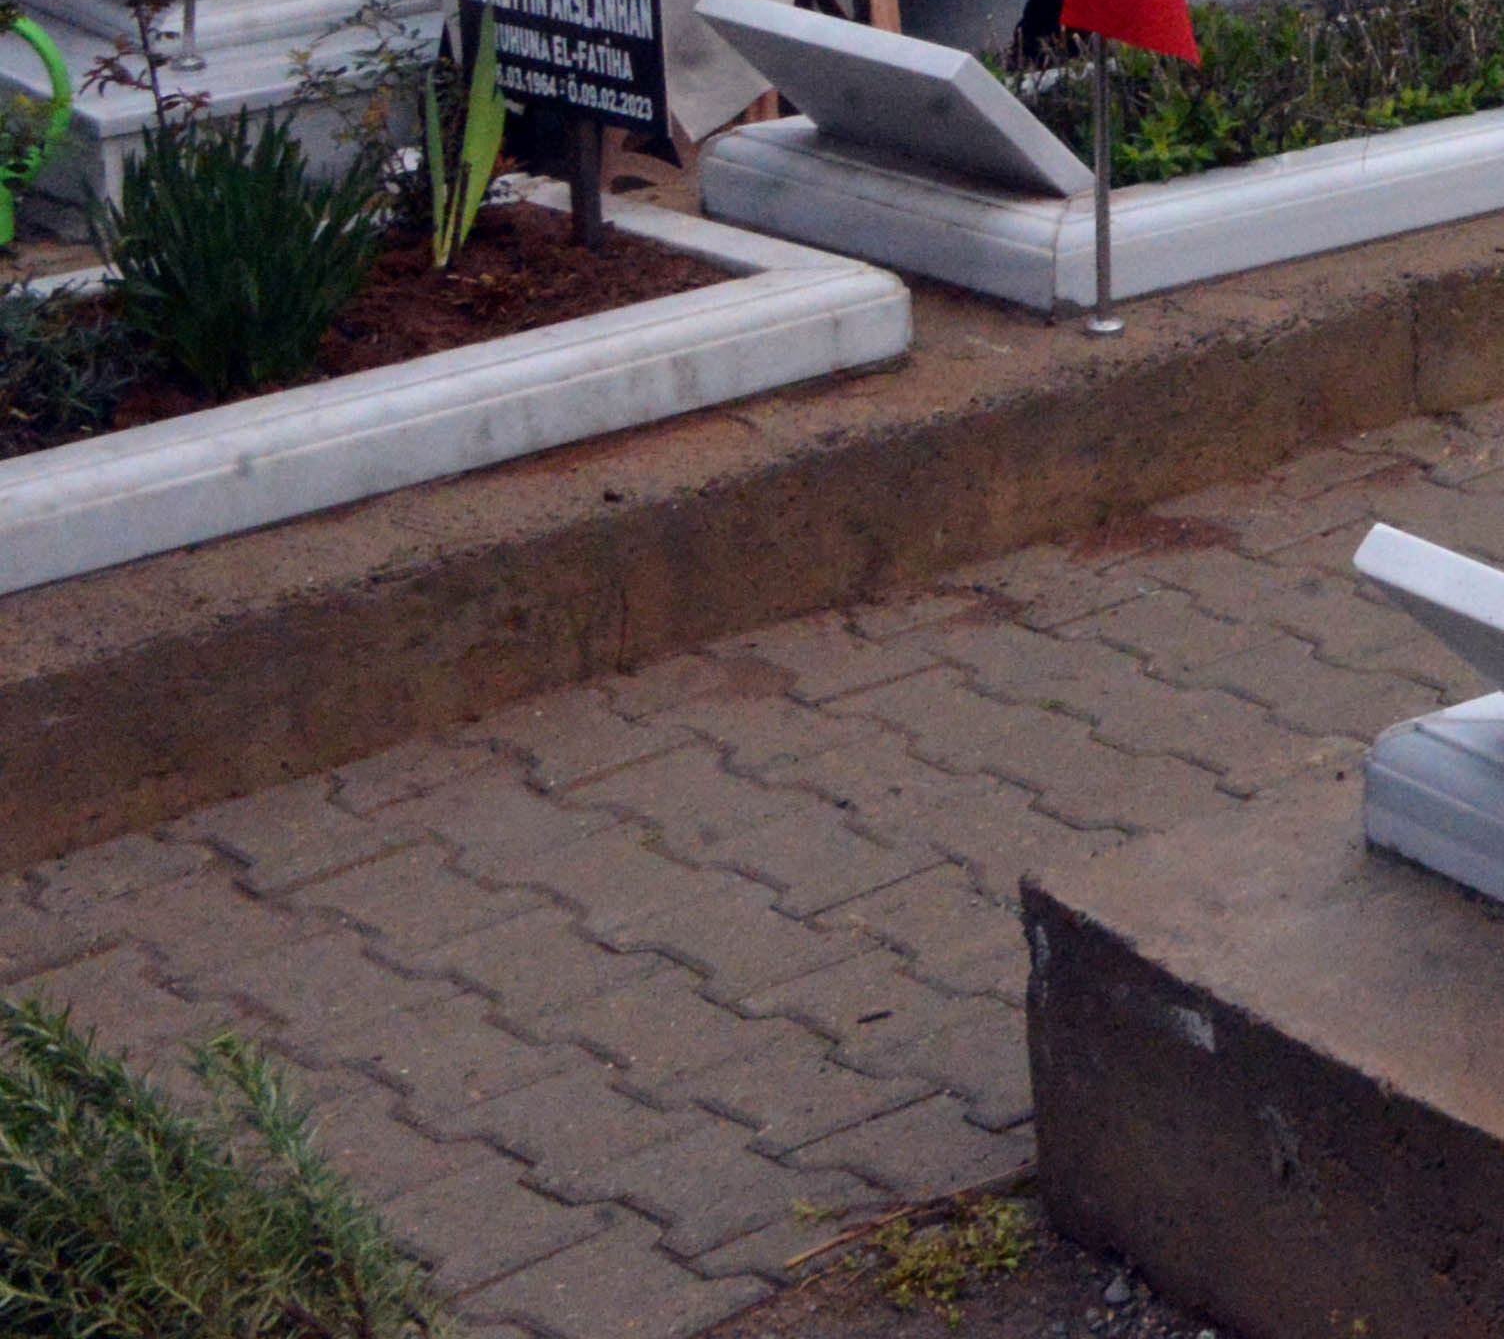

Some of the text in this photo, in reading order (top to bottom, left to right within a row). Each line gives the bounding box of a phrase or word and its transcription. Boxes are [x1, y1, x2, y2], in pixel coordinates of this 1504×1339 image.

[494, 23, 634, 82] UHUNA EL-FATİHA
[567, 73, 654, 121] Ö.09.02.2023
